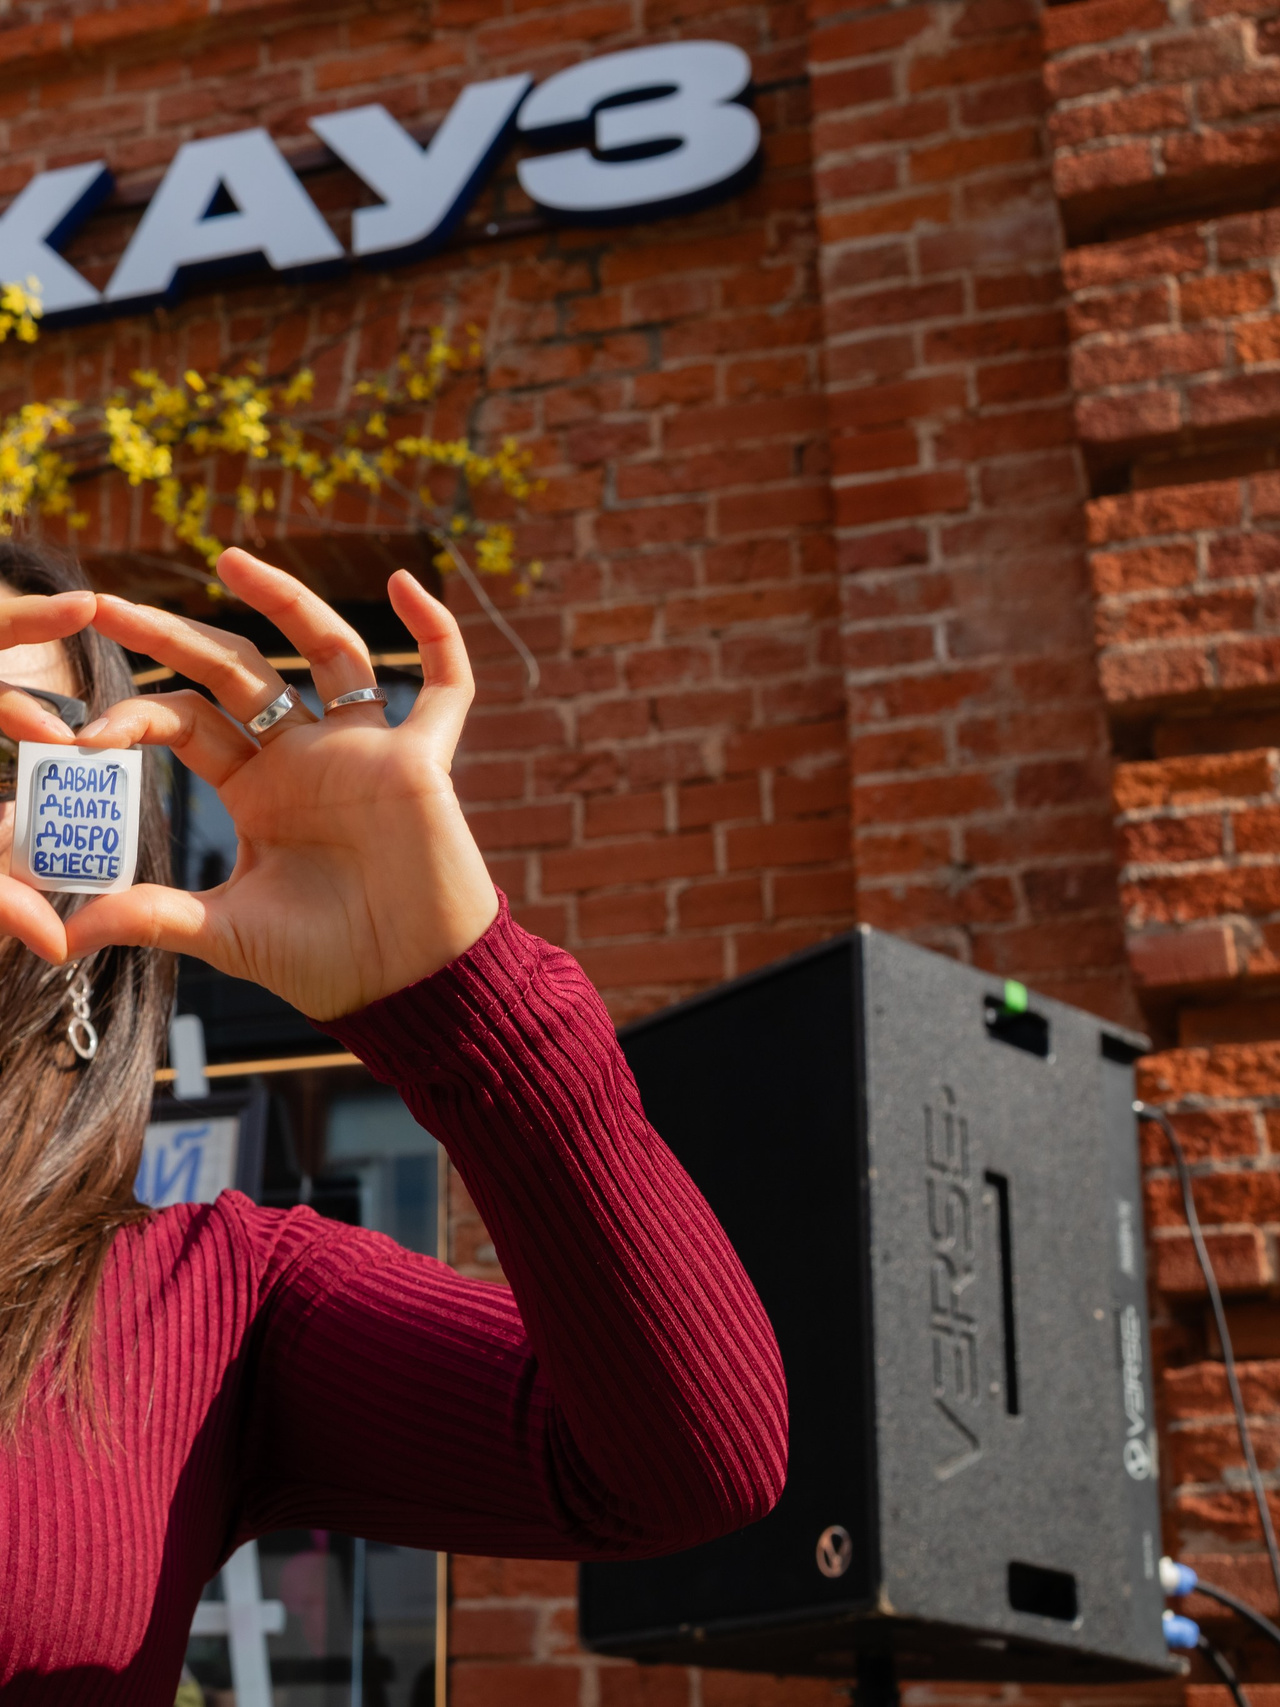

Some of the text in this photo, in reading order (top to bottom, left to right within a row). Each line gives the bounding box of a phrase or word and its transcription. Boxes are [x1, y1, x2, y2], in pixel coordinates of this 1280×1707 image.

[41, 763, 120, 796] ДАВАЙ
[39, 793, 122, 821] ДЕЛАТЬ
[36, 820, 120, 854] ДОБРО
[33, 850, 121, 879] ВМЕСТЕ
